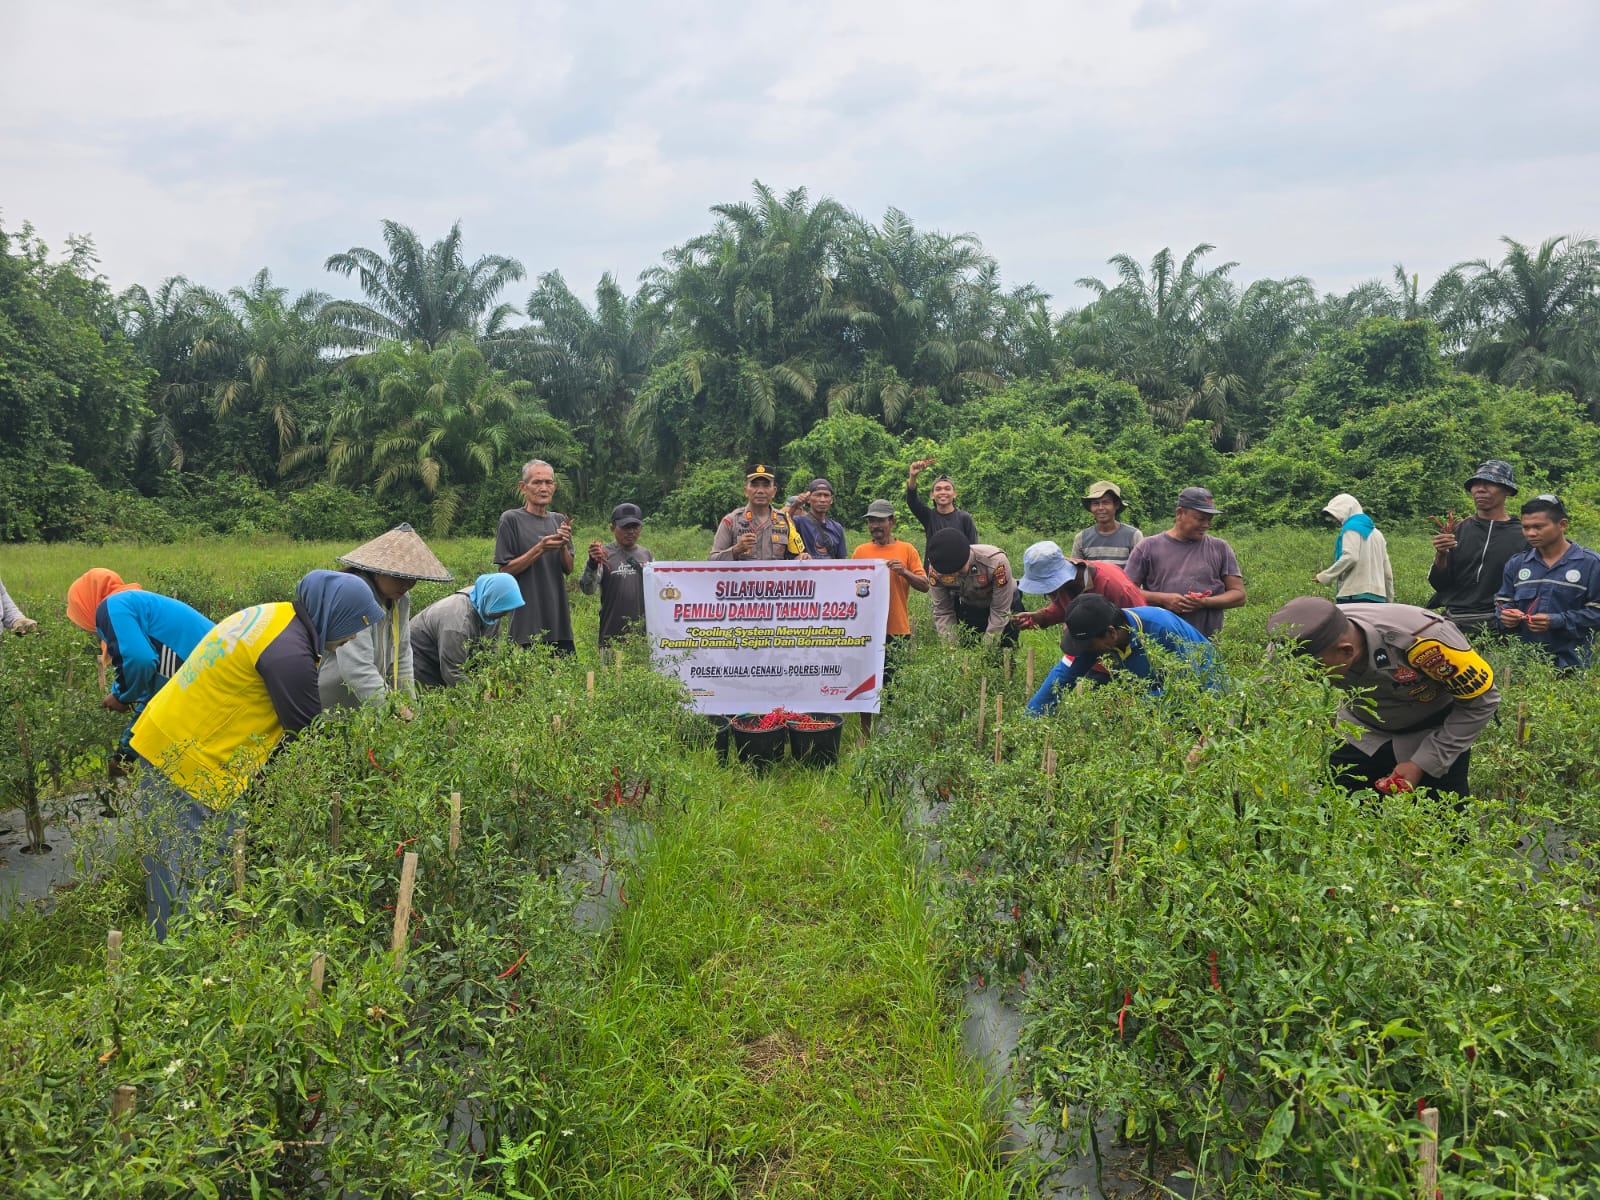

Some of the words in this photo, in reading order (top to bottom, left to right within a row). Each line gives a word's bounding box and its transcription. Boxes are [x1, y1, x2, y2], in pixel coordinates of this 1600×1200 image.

[715, 579, 815, 599] SILATURAHMI
[673, 602, 725, 620] PEMILU
[728, 602, 772, 620] DAMAI
[775, 601, 819, 619] TAHUN
[821, 601, 856, 619] 2024
[734, 626, 774, 637] System
[776, 625, 845, 637] Mewujudkan
[660, 638, 698, 648] Pemilu
[700, 638, 738, 648] Damai,
[740, 637, 771, 648] Sejuk
[773, 637, 796, 647] Dan
[690, 666, 721, 676] POLSEK
[723, 666, 749, 676] KUALA
[750, 665, 782, 675] CENAKU
[788, 665, 820, 675] POLRES
[821, 664, 841, 675] INHU
